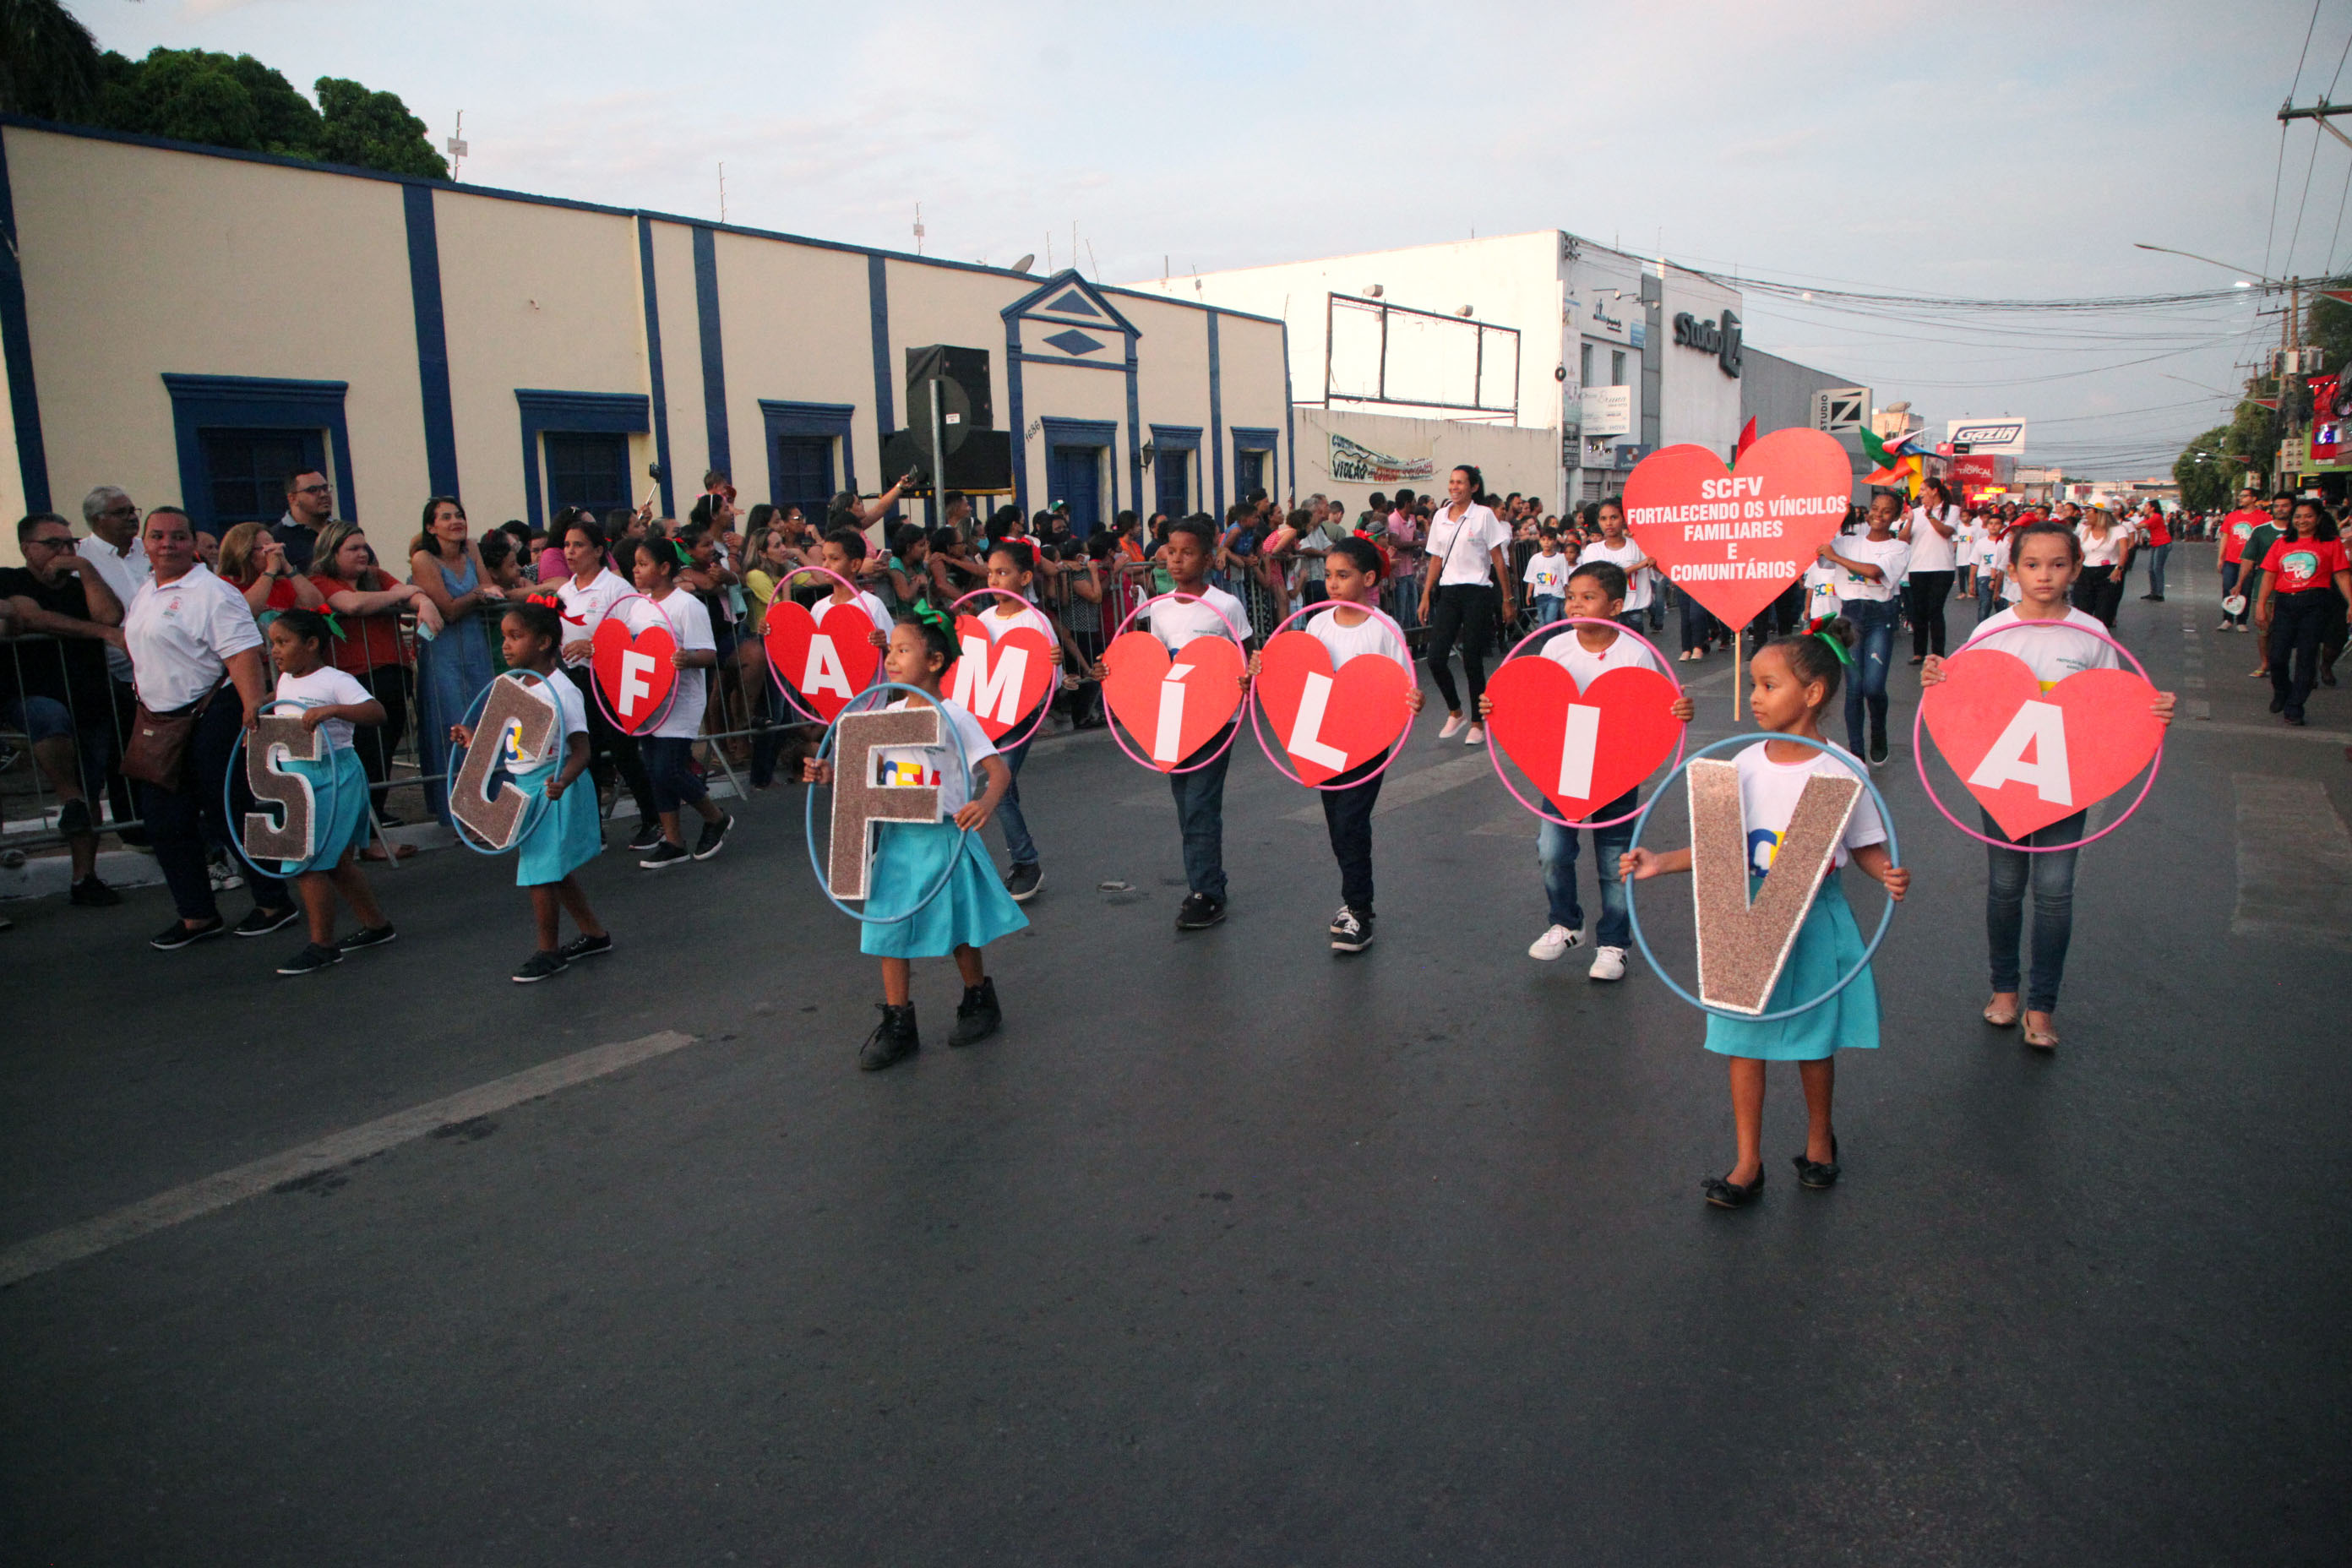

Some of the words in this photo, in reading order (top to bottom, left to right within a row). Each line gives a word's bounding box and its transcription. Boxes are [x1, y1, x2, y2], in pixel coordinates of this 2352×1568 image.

[1673, 312, 1723, 354] Studio
[1820, 395, 1828, 431] STUDIO
[1957, 426, 2019, 443] GAZIN
[1627, 502, 1740, 525] FORTALECENDO
[1744, 501, 1764, 519] OS
[1769, 494, 1848, 518] VÍNCULOS
[1701, 476, 1763, 499] SCFV
[1684, 520, 1783, 542] FAMILIARES
[1727, 543, 1737, 560] E
[1537, 572, 1557, 586] SCFV
[1670, 558, 1796, 582] COMUNITÁRIOS
[618, 651, 656, 716] F
[801, 634, 854, 699] A
[950, 634, 1028, 727] M
[1288, 671, 1348, 773] L
[1557, 703, 1601, 800] I
[1967, 700, 2074, 807] A
[244, 712, 323, 862] S
[449, 673, 558, 849] C
[828, 705, 944, 901] F
[1687, 758, 1864, 1015] V
